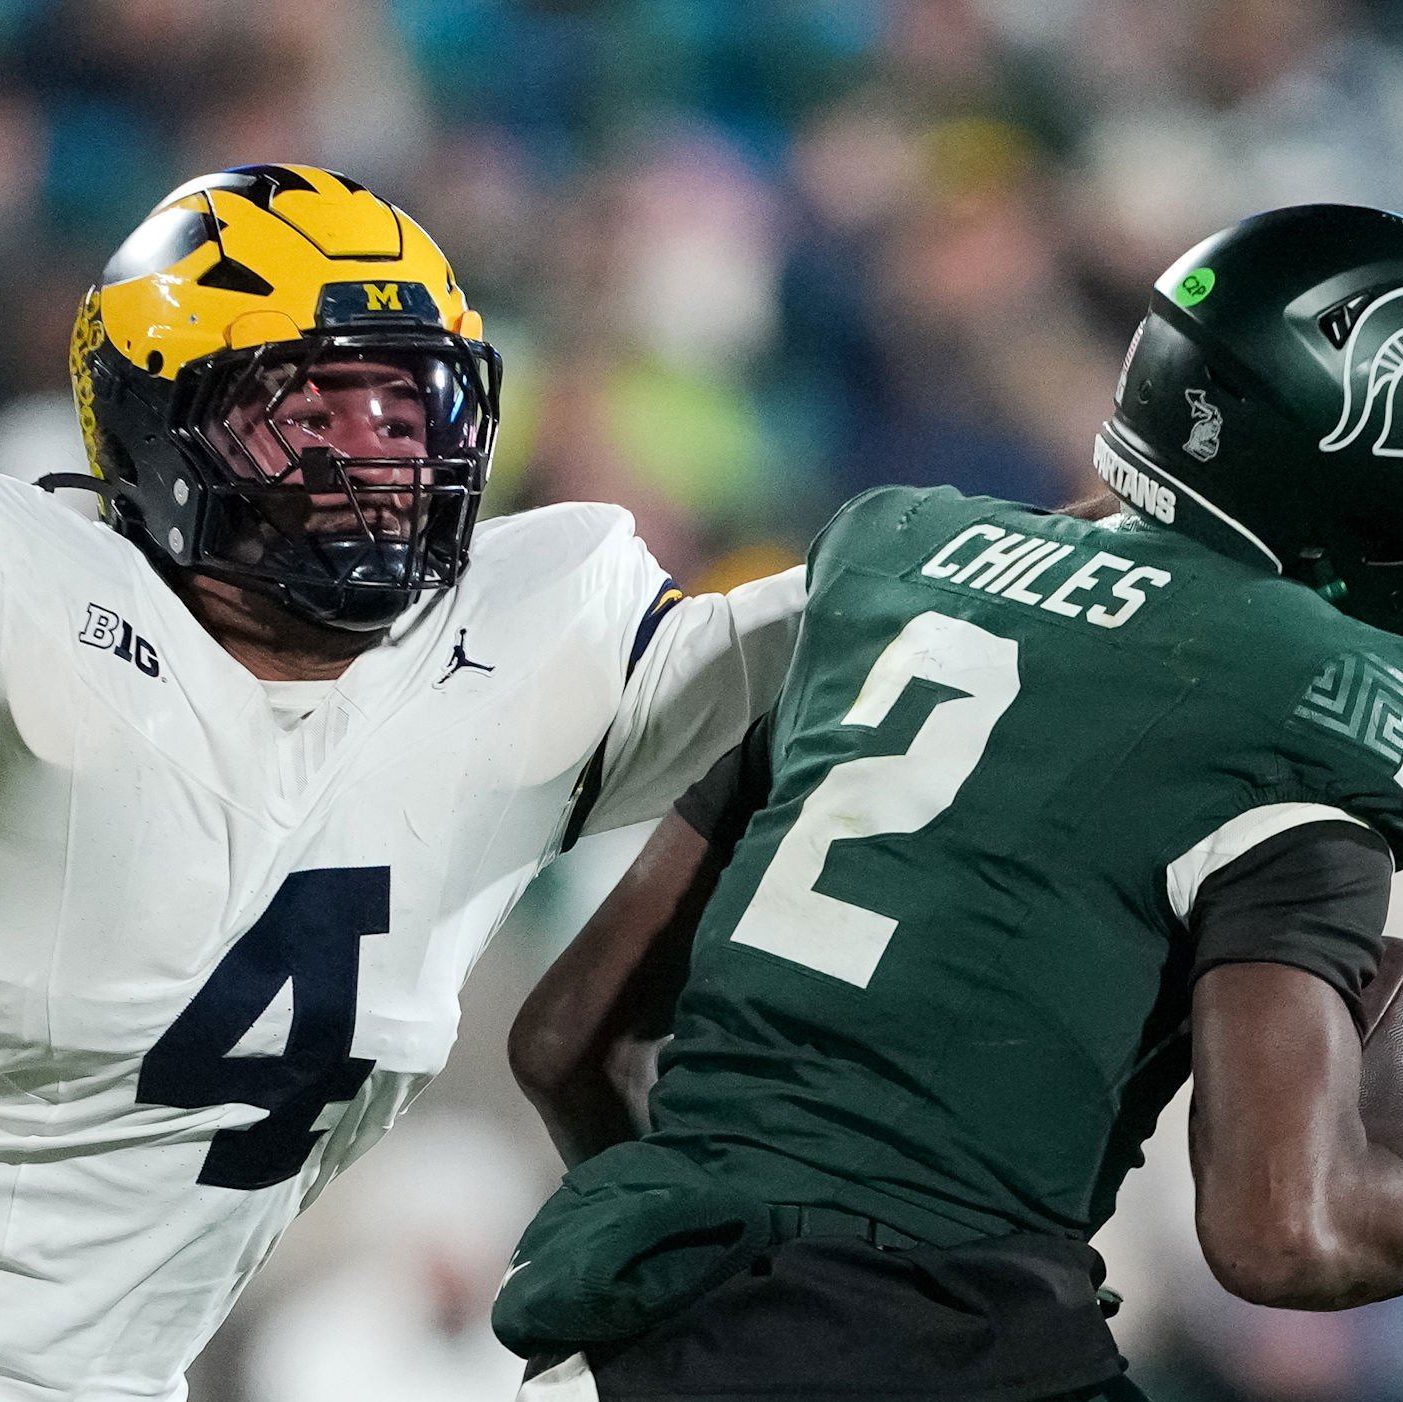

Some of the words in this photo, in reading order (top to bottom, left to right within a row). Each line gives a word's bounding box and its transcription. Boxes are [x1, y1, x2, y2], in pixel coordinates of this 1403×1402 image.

[362, 283, 403, 311] M
[919, 523, 1172, 629] CHILES
[729, 610, 1022, 990] 2
[134, 865, 391, 1191] 4
